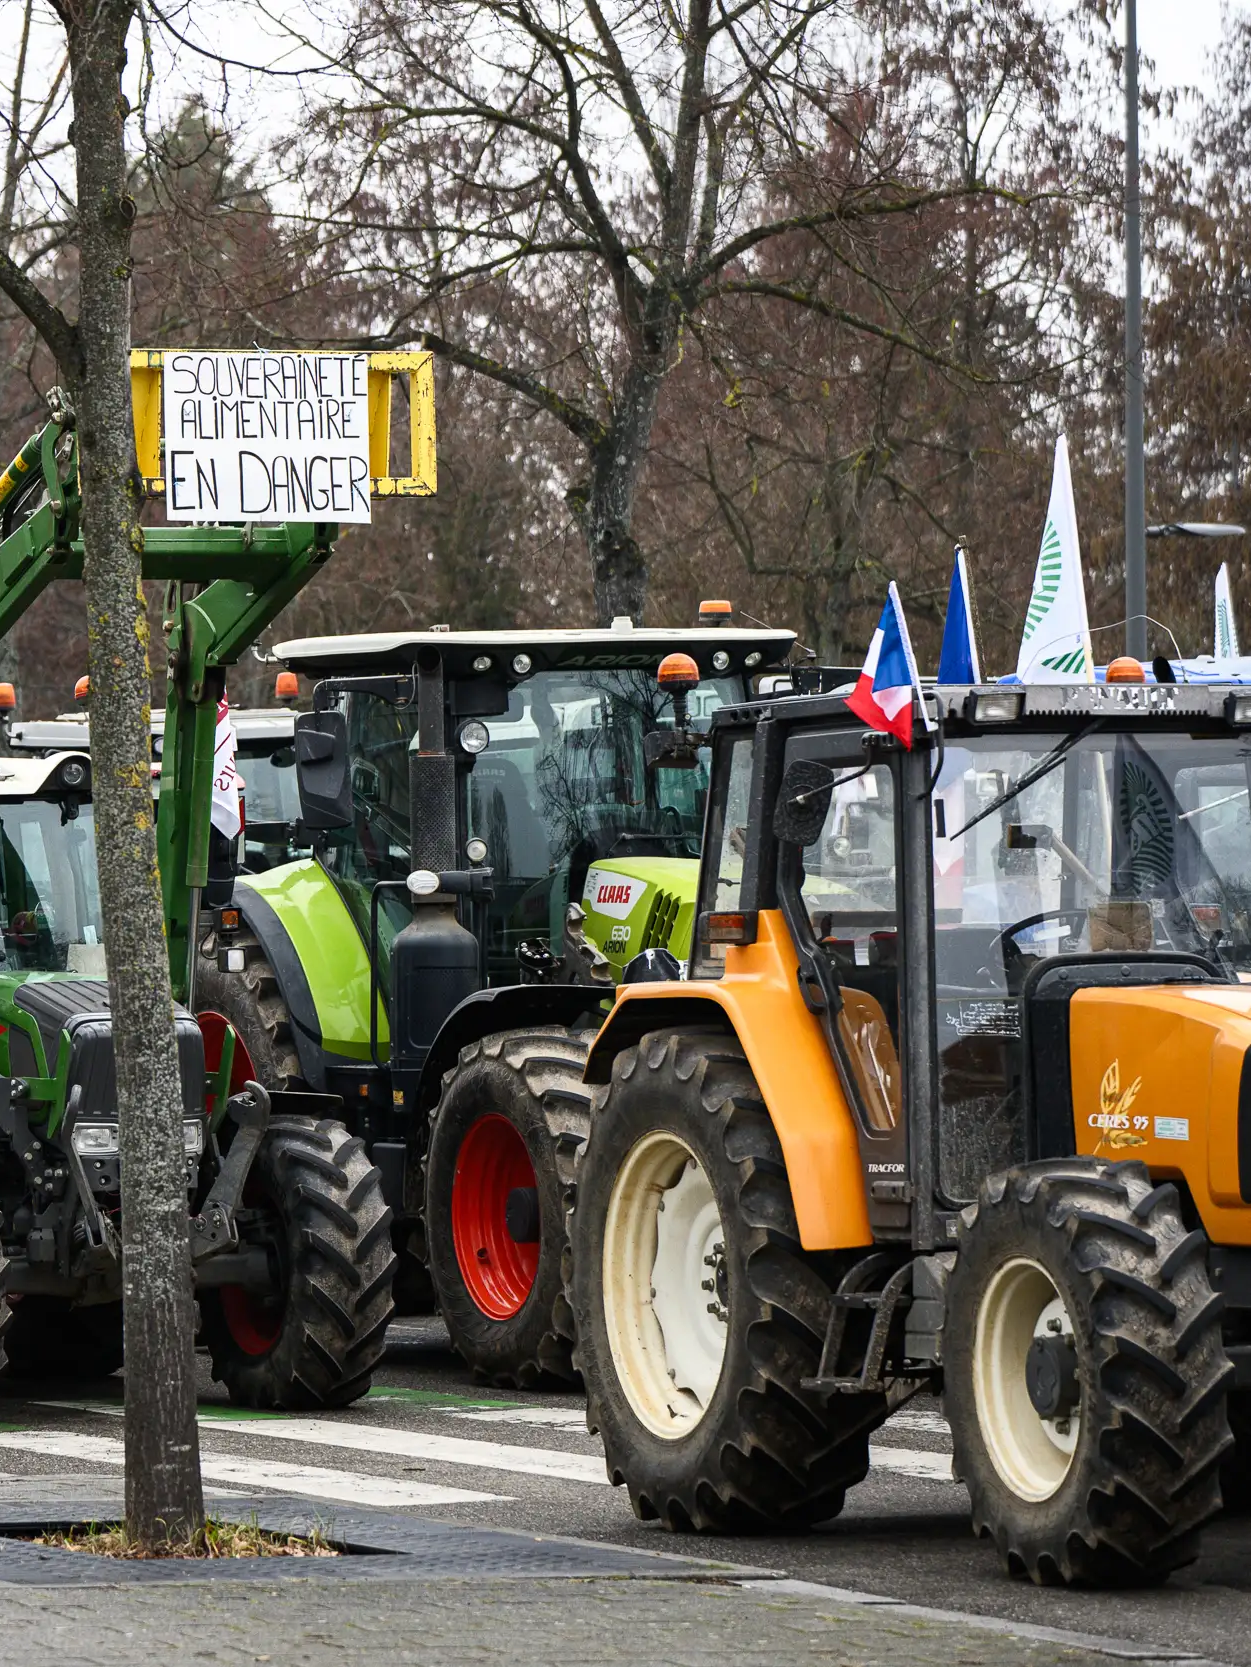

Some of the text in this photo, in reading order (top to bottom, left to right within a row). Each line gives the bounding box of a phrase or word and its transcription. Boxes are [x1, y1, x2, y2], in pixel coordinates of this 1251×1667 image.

[170, 450, 370, 514] EN DANGER
[596, 885, 632, 904] CLAAS
[611, 925, 631, 941] 630
[602, 940, 627, 954] ARION
[1088, 1113, 1130, 1129] CERES
[1132, 1115, 1150, 1130] 95
[867, 1163, 905, 1173] TRACFOR
